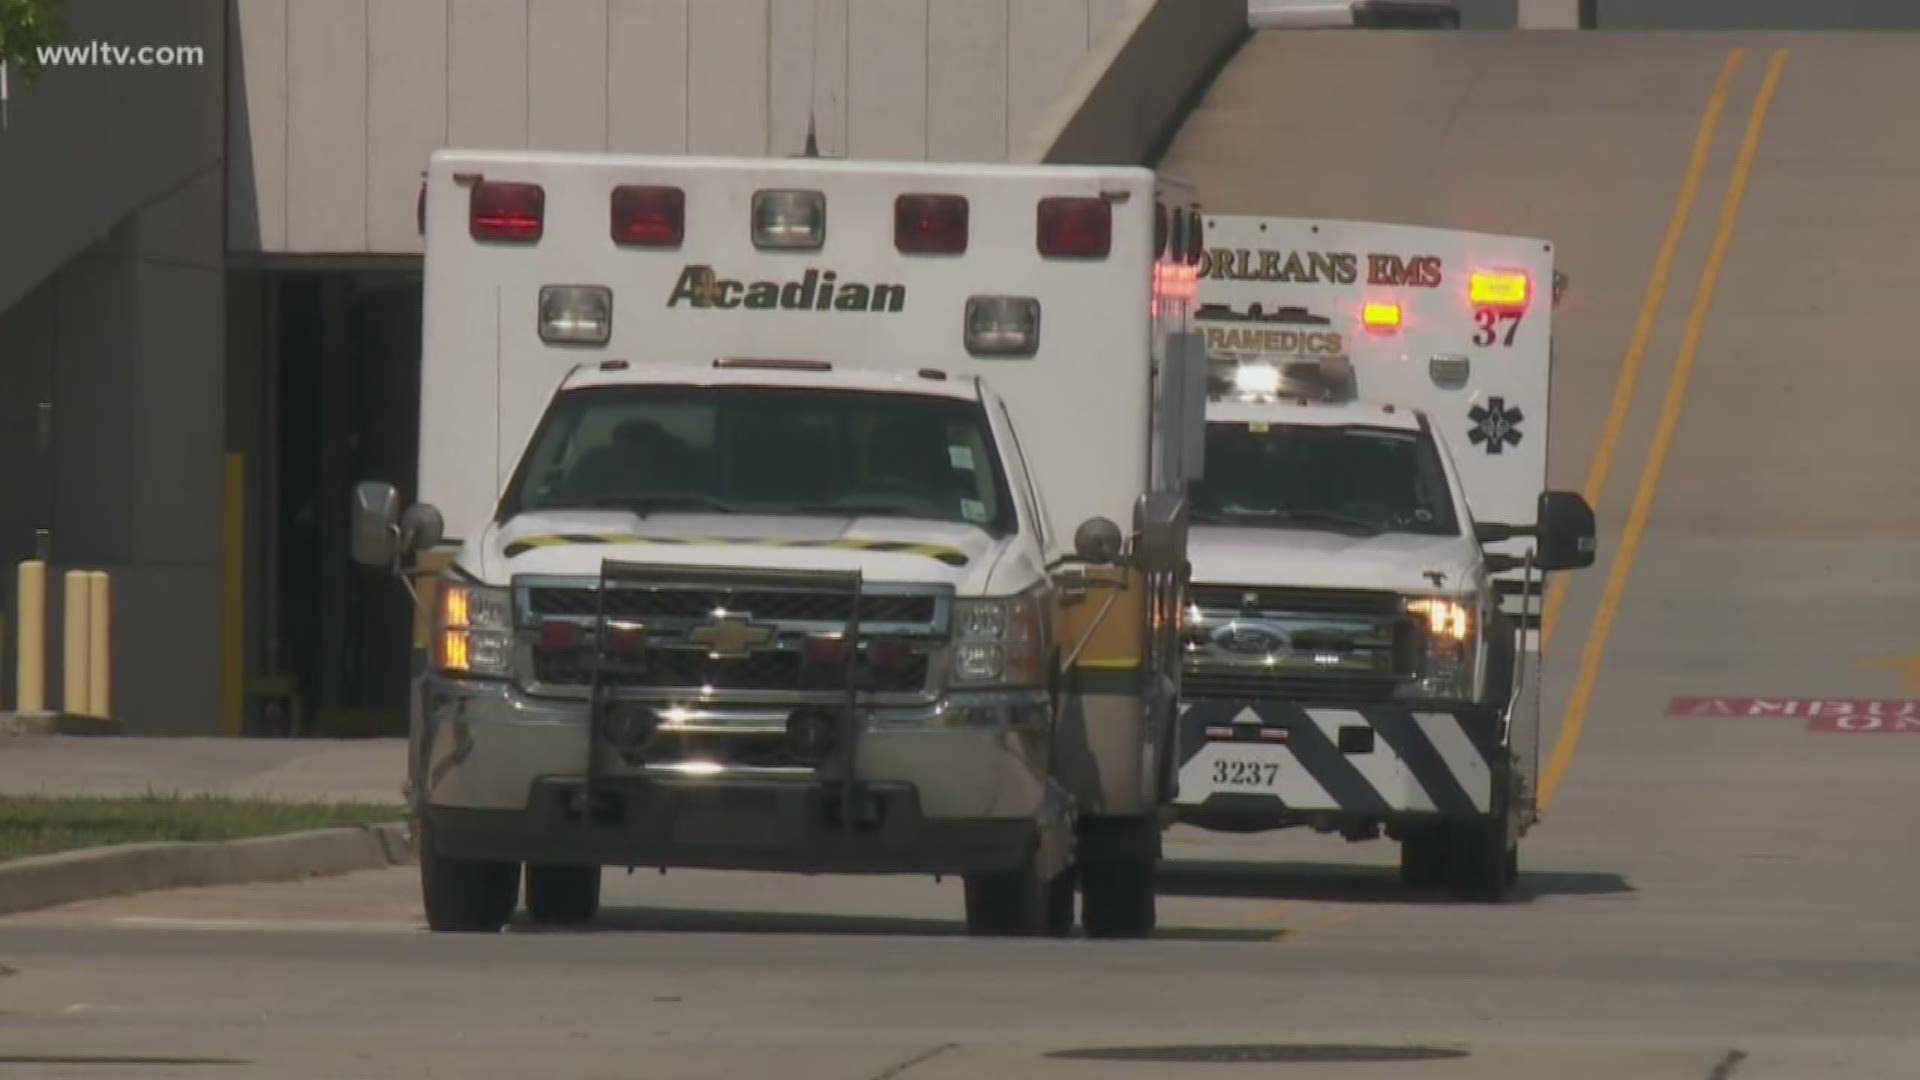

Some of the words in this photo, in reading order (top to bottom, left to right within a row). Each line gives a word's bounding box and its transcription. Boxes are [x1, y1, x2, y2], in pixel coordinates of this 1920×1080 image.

[667, 264, 906, 312] Acadian
[1366, 253, 1442, 288] EMS
[1194, 326, 1342, 353] RAMEDICS
[1472, 308, 1523, 348] 37
[1212, 760, 1280, 786] 3237
